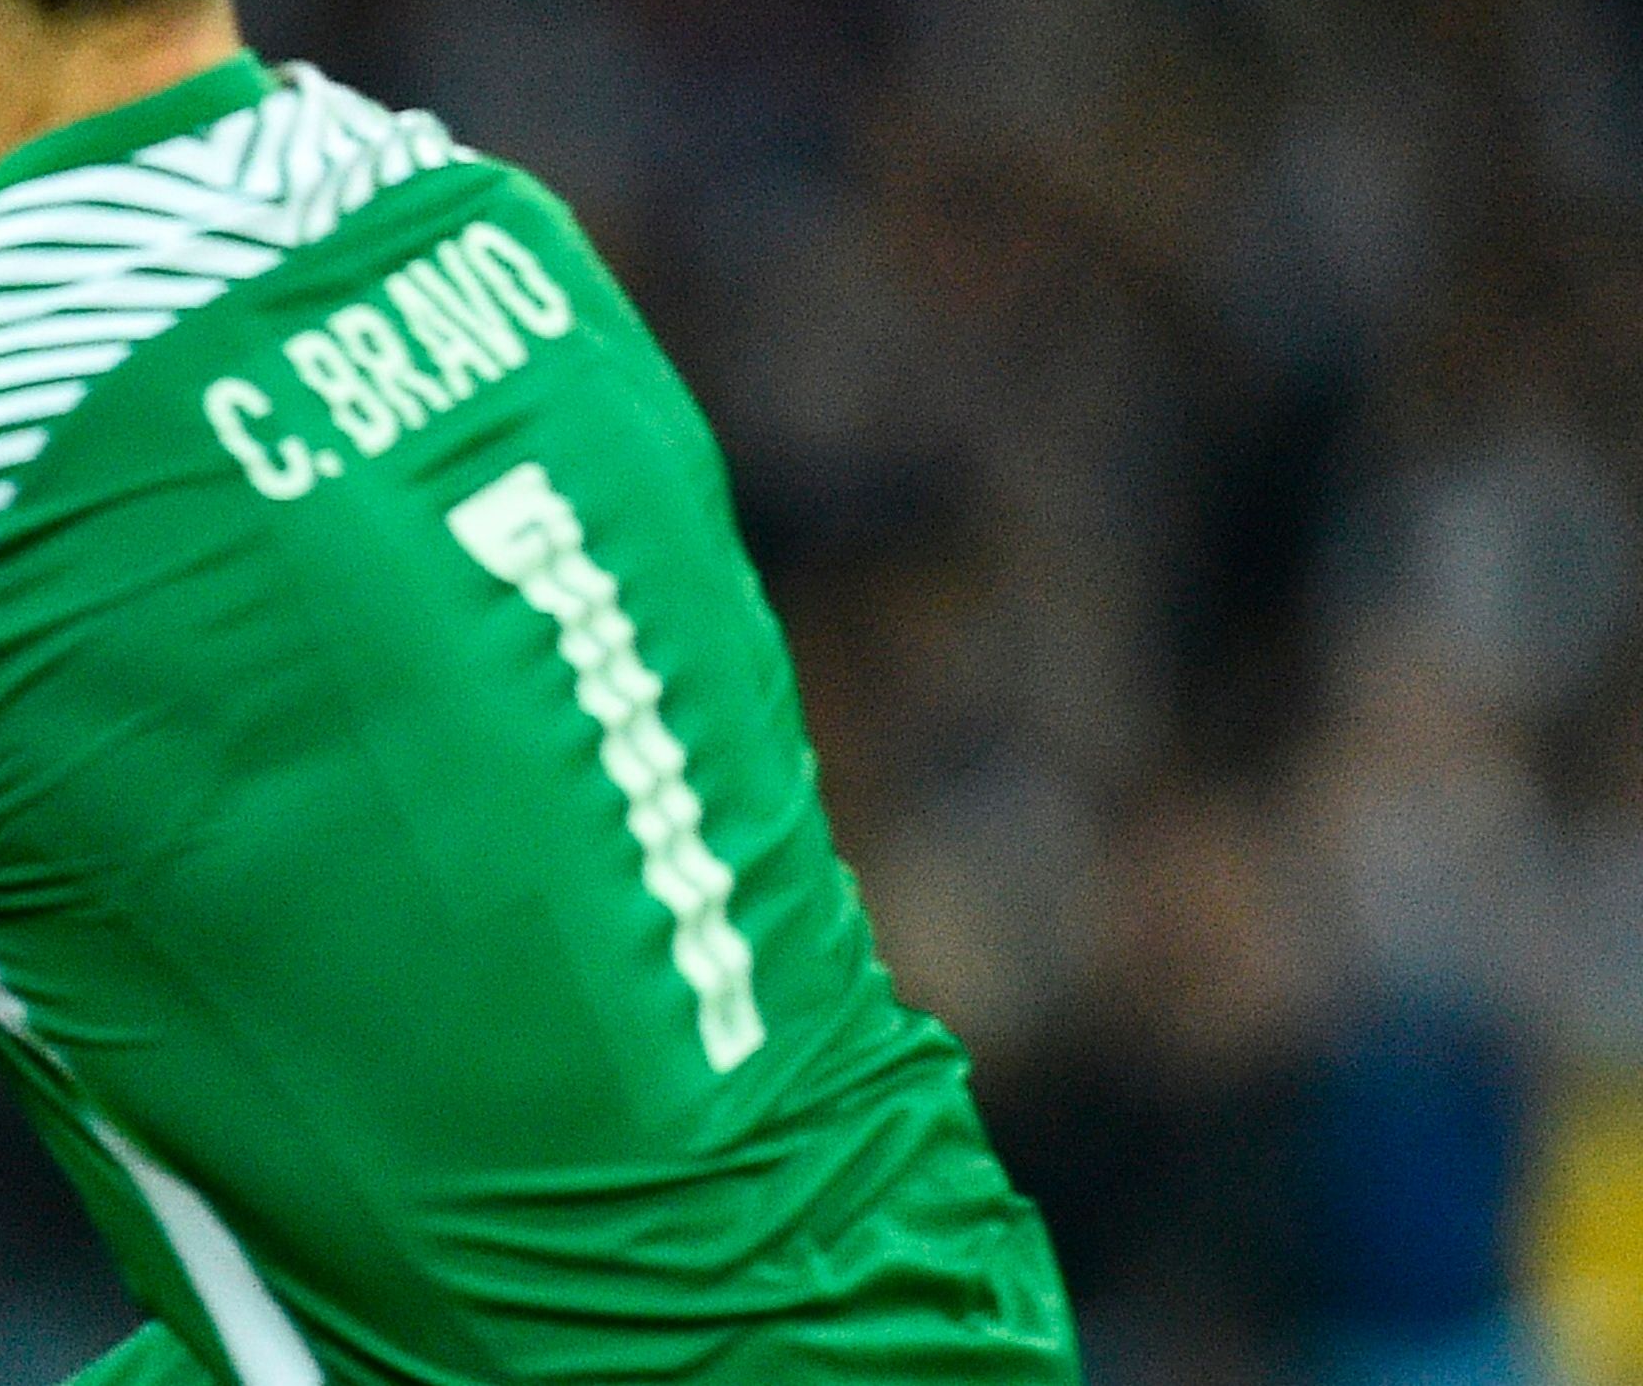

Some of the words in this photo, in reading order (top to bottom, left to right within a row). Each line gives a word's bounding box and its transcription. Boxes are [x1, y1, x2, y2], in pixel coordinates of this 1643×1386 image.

[203, 377, 344, 501] C.
[282, 221, 572, 459] BRAVO
[445, 461, 768, 1075] 1
